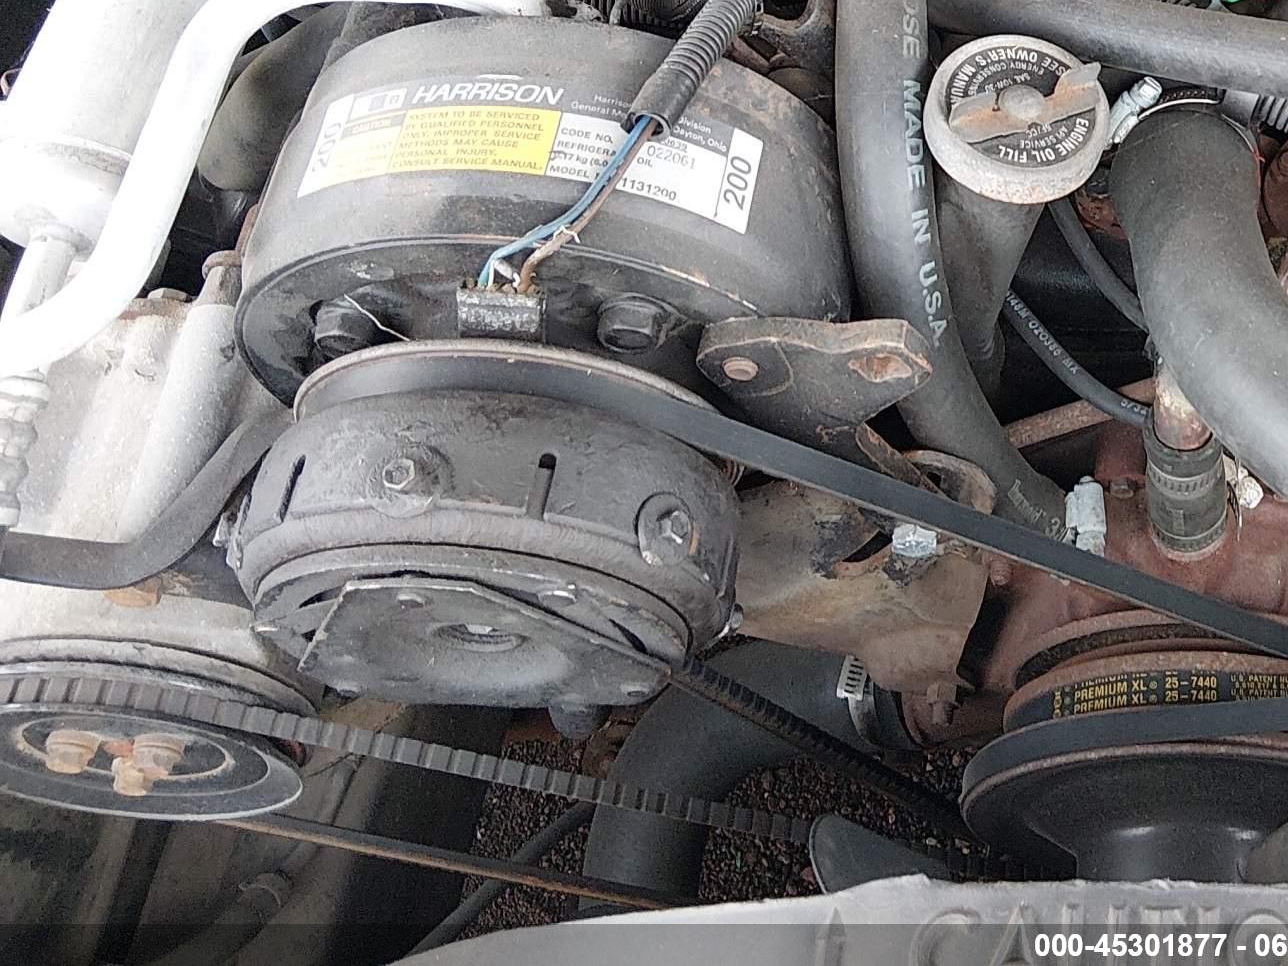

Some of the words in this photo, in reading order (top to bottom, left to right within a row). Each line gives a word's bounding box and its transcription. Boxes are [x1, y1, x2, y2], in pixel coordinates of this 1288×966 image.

[975, 48, 1038, 66] OWNER'S
[1041, 56, 1066, 76] SEE
[951, 63, 976, 105] MANUA
[412, 82, 564, 106] HARRISON
[452, 111, 465, 119] TO
[470, 110, 482, 118] BE
[486, 110, 540, 121] SERVICED
[571, 101, 609, 115] General
[420, 120, 477, 130] QUALIFIED
[480, 120, 544, 132] PERSONNEL
[561, 127, 591, 139] CODE
[433, 130, 487, 138] IMPROPER
[494, 130, 541, 141] SERVICE
[673, 125, 706, 145] Dayton,
[707, 138, 727, 152] Ohio
[903, 80, 926, 189] MADE
[1019, 134, 1058, 149] SERVICE
[1058, 117, 1089, 156] ENGINE
[452, 139, 478, 147] MAY
[481, 139, 519, 148] CAUSE
[557, 140, 617, 157] REFRIGERA
[442, 157, 488, 166] SERVICE
[575, 156, 588, 166] kg
[637, 156, 653, 168] OIL
[998, 145, 1028, 163] FILL
[1034, 148, 1056, 162] OIL
[549, 164, 590, 179] MODEL
[723, 155, 751, 211] 200
[911, 209, 932, 245] IN
[1249, 675, 1277, 683] PATENT
[1074, 681, 1127, 702] PREMIUM
[1249, 689, 1277, 697] PATENT
[1074, 693, 1127, 715] PREMIUM
